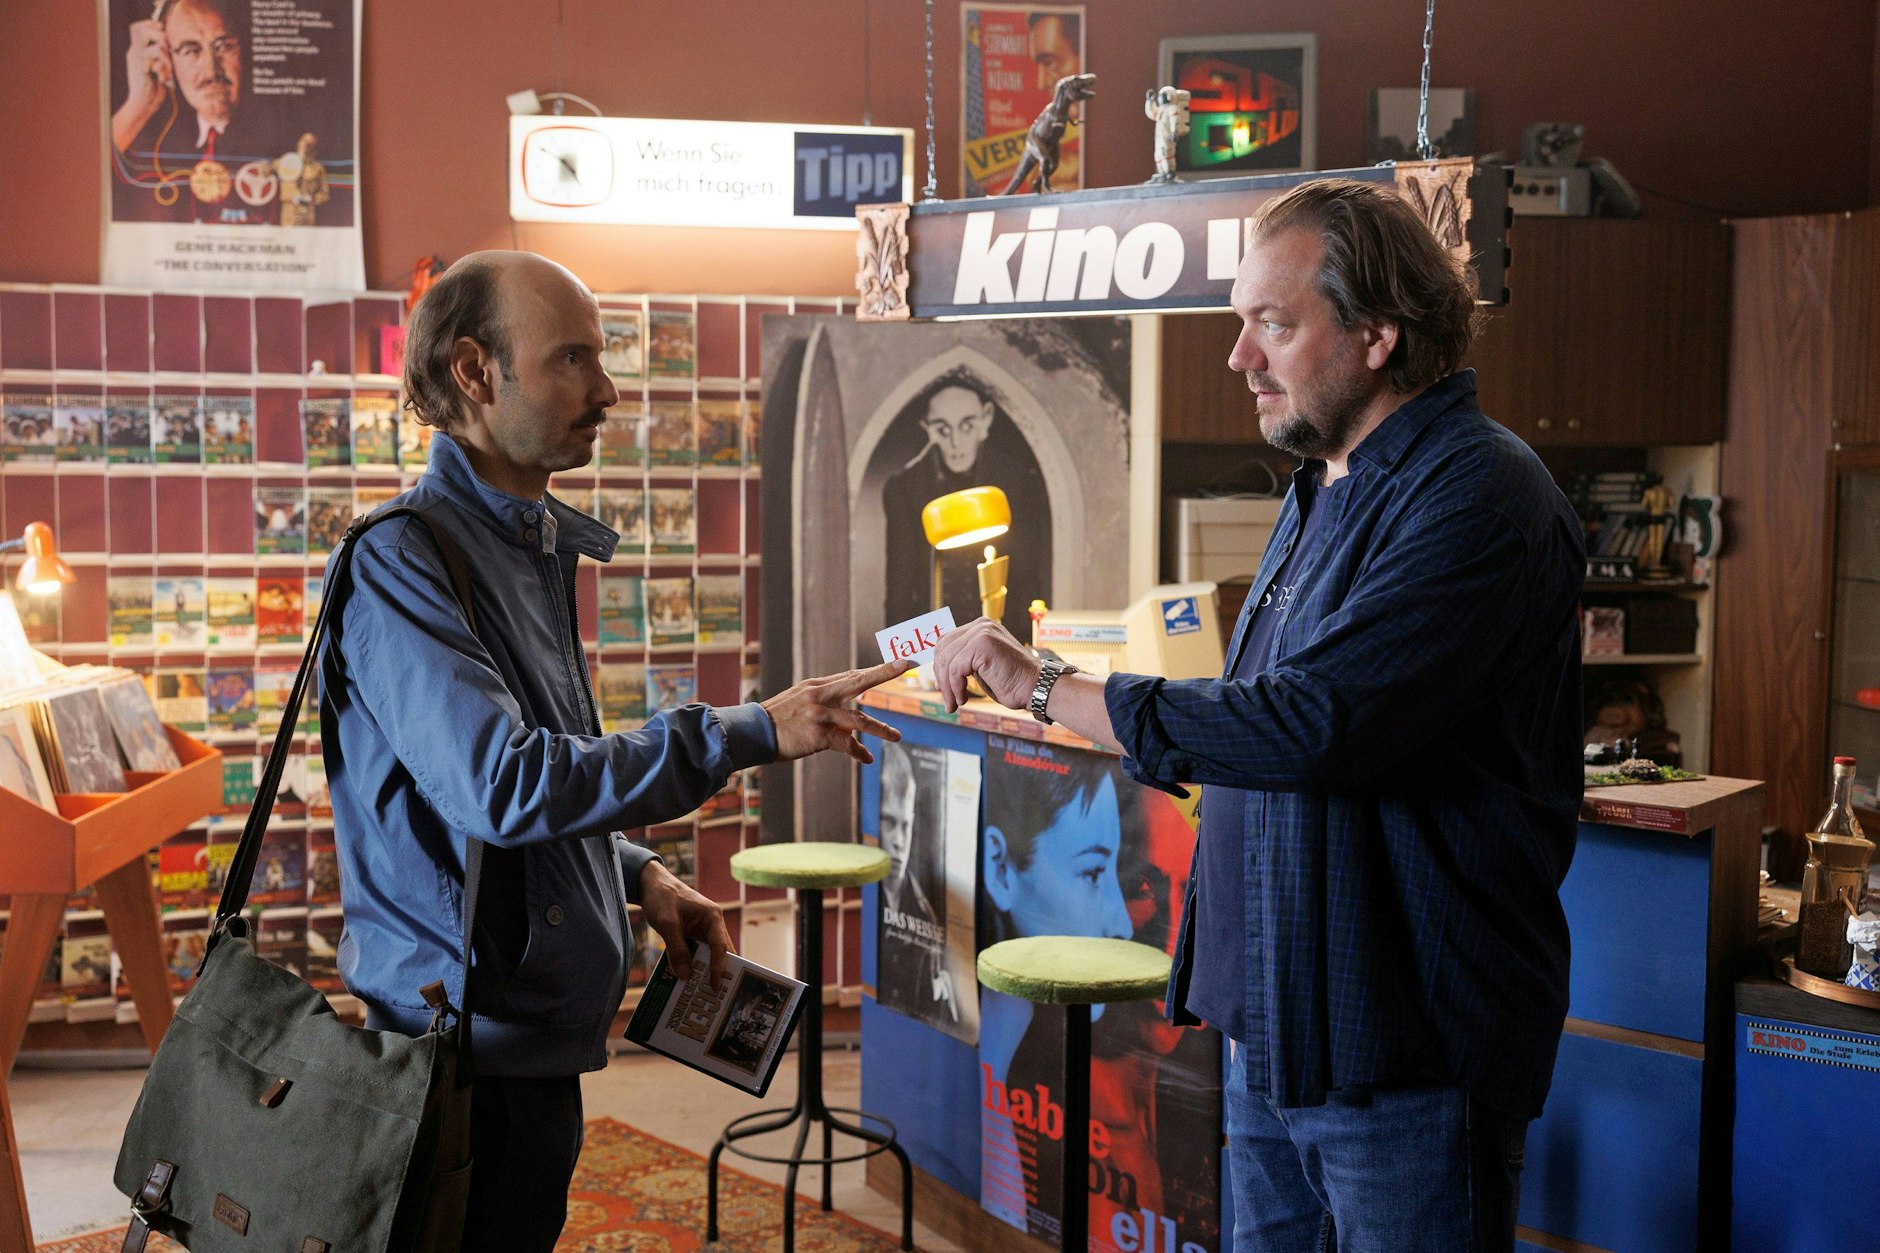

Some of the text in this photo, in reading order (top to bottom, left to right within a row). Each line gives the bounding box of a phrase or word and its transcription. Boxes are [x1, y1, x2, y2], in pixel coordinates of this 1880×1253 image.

[635, 140, 742, 164] Wenn Sie
[636, 173, 690, 193] mich
[796, 145, 900, 203] Tipp
[952, 206, 1186, 306] kino
[888, 624, 944, 661] fakt
[1003, 751, 1072, 776] Almodóvar
[883, 906, 907, 930] DAS
[1751, 1031, 1806, 1053] KINO
[1809, 1046, 1825, 1056] Die
[1834, 1045, 1854, 1054] zum
